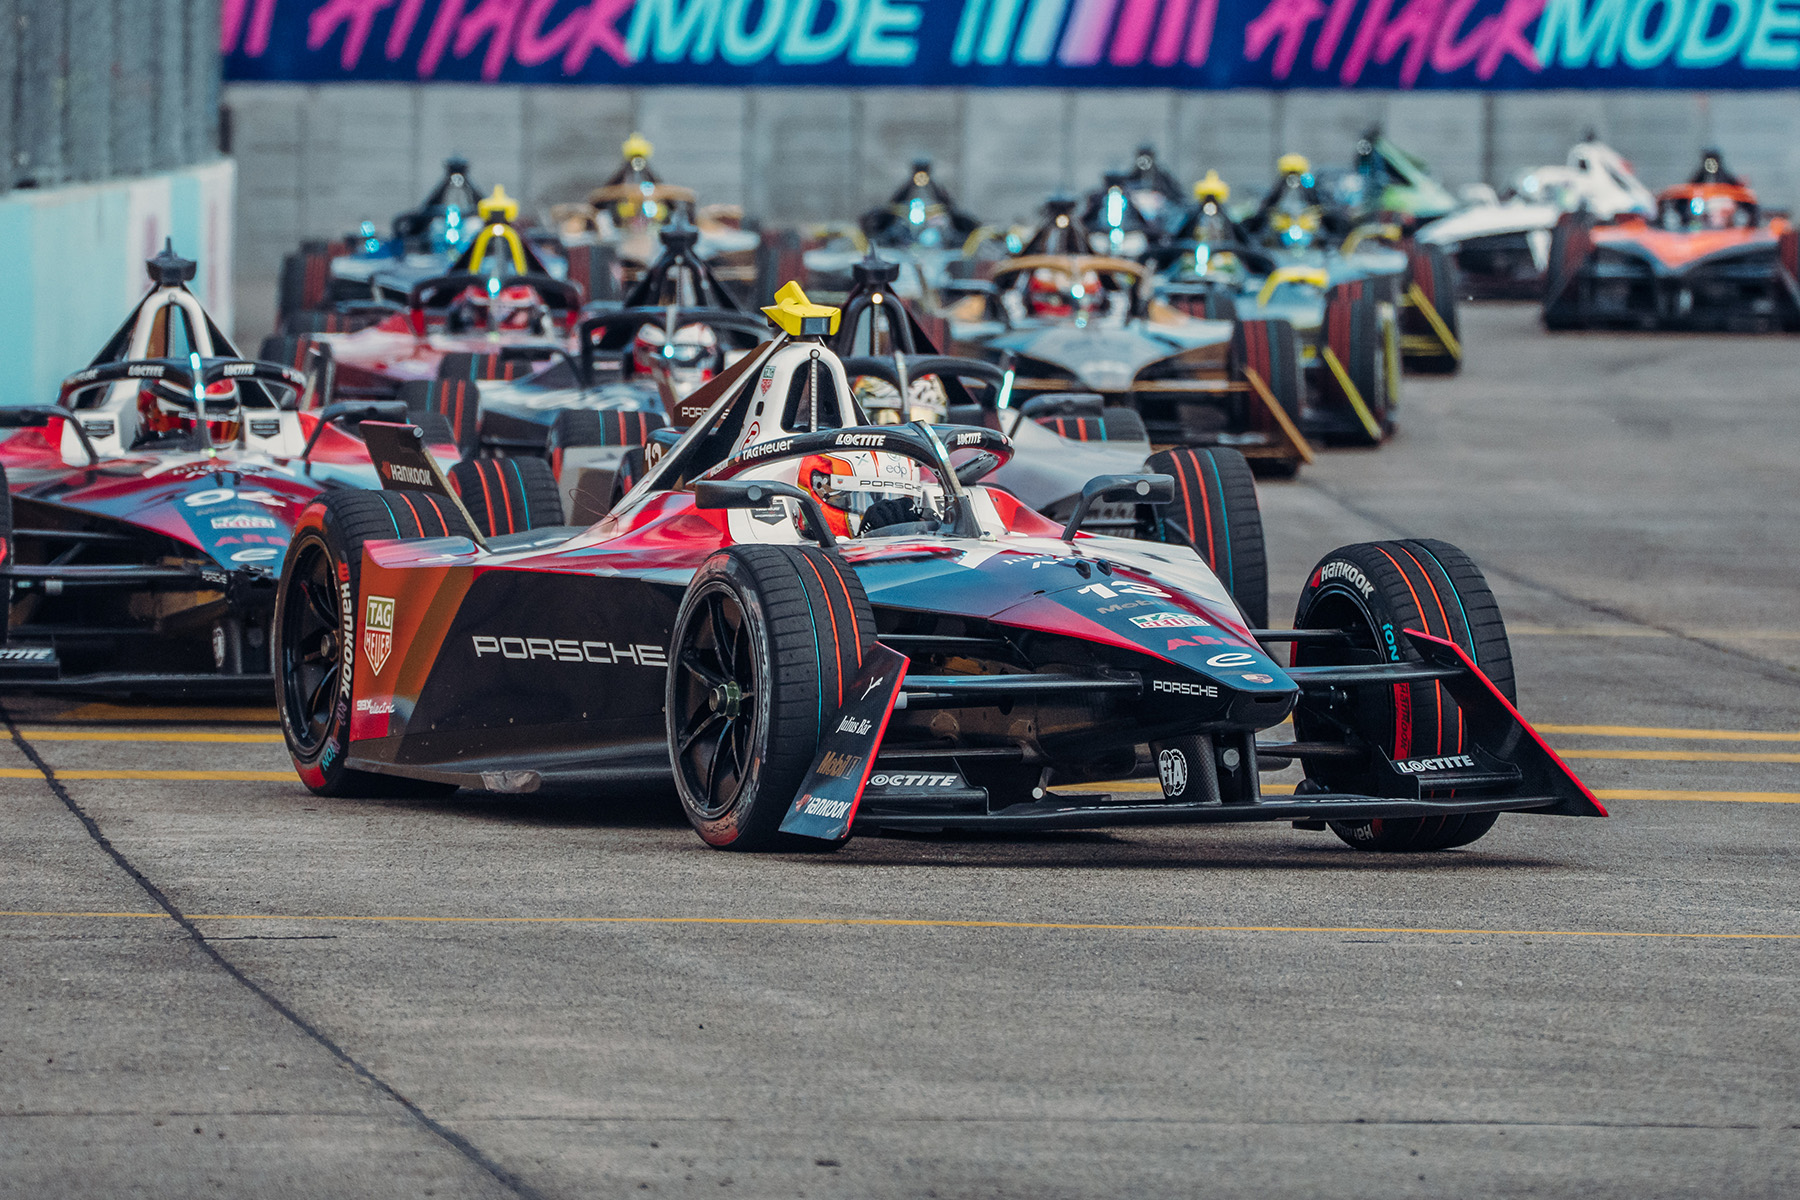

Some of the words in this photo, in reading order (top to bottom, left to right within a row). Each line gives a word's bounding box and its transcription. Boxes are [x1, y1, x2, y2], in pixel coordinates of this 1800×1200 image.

[625, 0, 923, 66] MODE
[835, 433, 887, 447] LOCTITE
[957, 433, 982, 446] LOCTITE
[885, 462, 908, 478] edp
[1077, 580, 1173, 600] 13
[368, 602, 392, 627] TAG
[366, 632, 391, 668] HEUER
[472, 635, 669, 667] PORSCHE
[1153, 680, 1219, 698] PORSCHE
[836, 715, 858, 734] Julius
[816, 751, 851, 778] Mobil
[1160, 759, 1184, 786] FIA
[1397, 755, 1475, 774] LOCTITE
[866, 774, 958, 787] OCTITE
